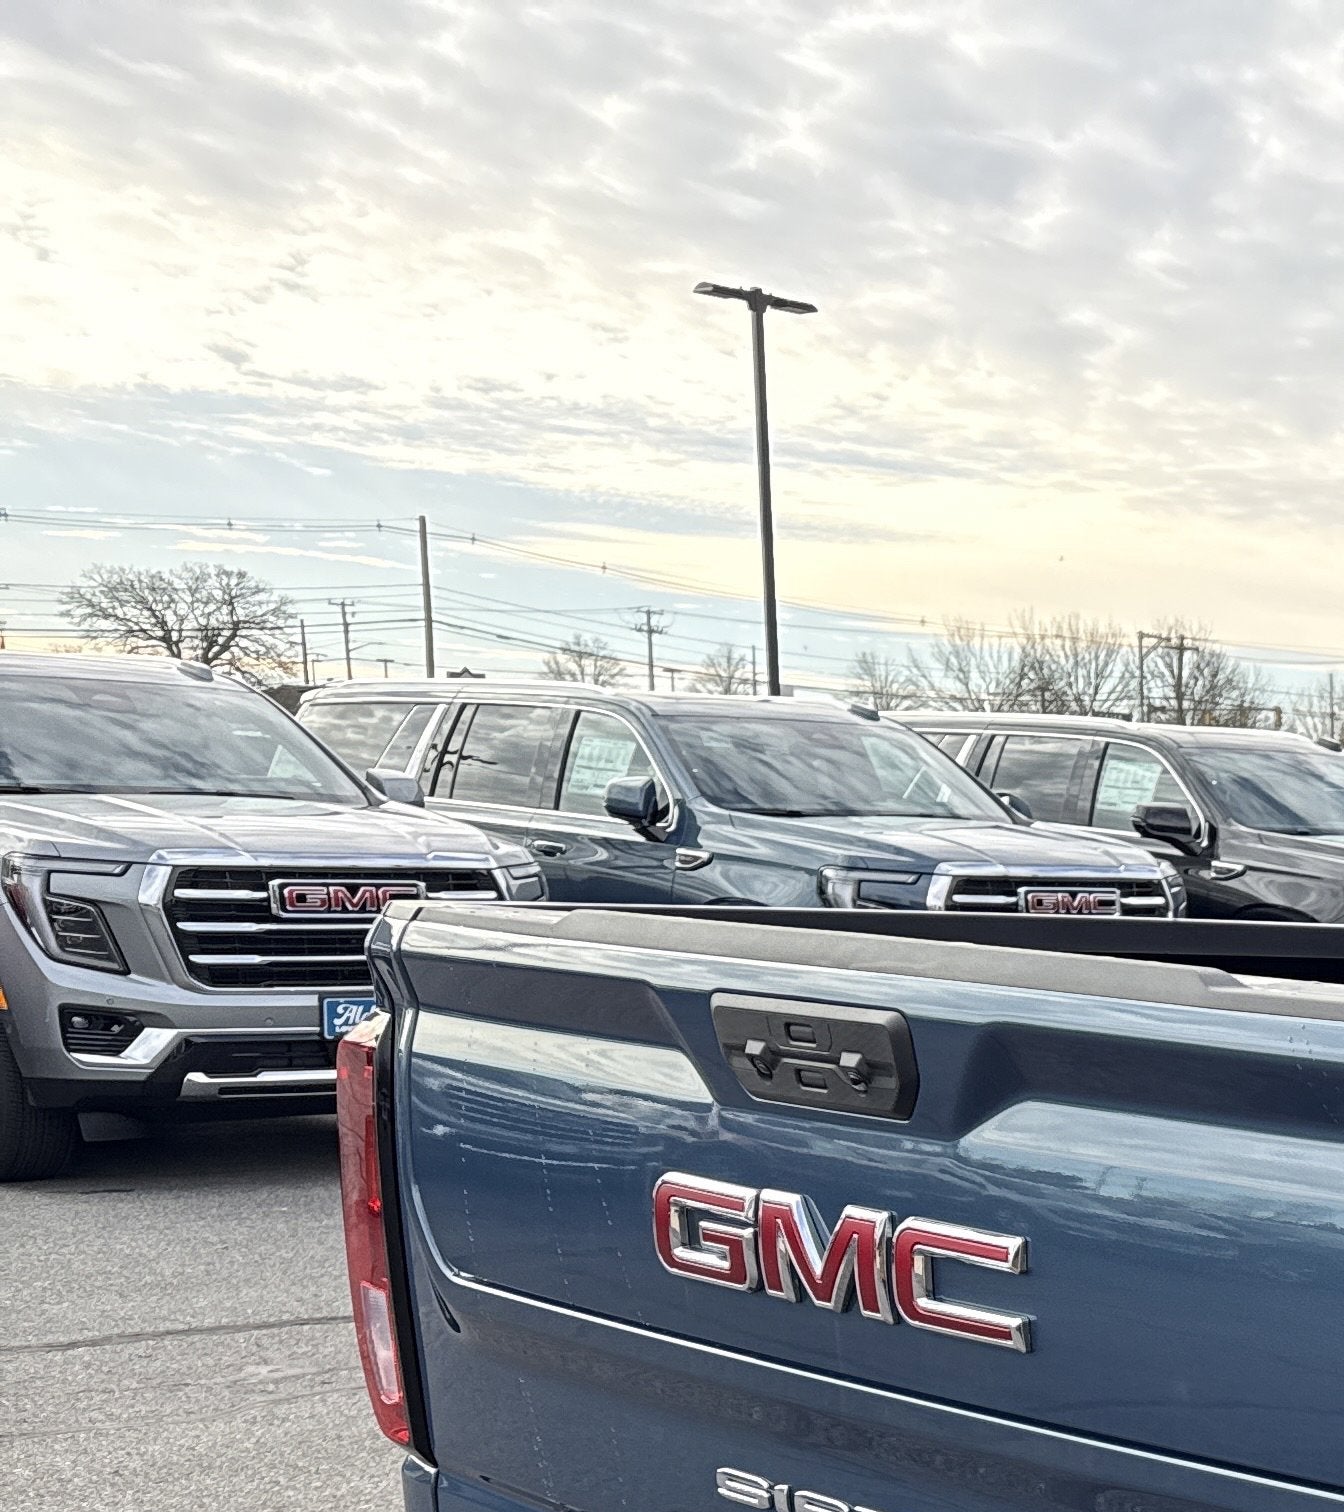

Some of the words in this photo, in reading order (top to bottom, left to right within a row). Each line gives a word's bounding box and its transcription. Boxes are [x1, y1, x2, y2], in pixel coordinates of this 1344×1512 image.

[283, 886, 417, 911] GMC
[1027, 892, 1117, 913] GMC
[652, 1171, 1032, 1354] GMC
